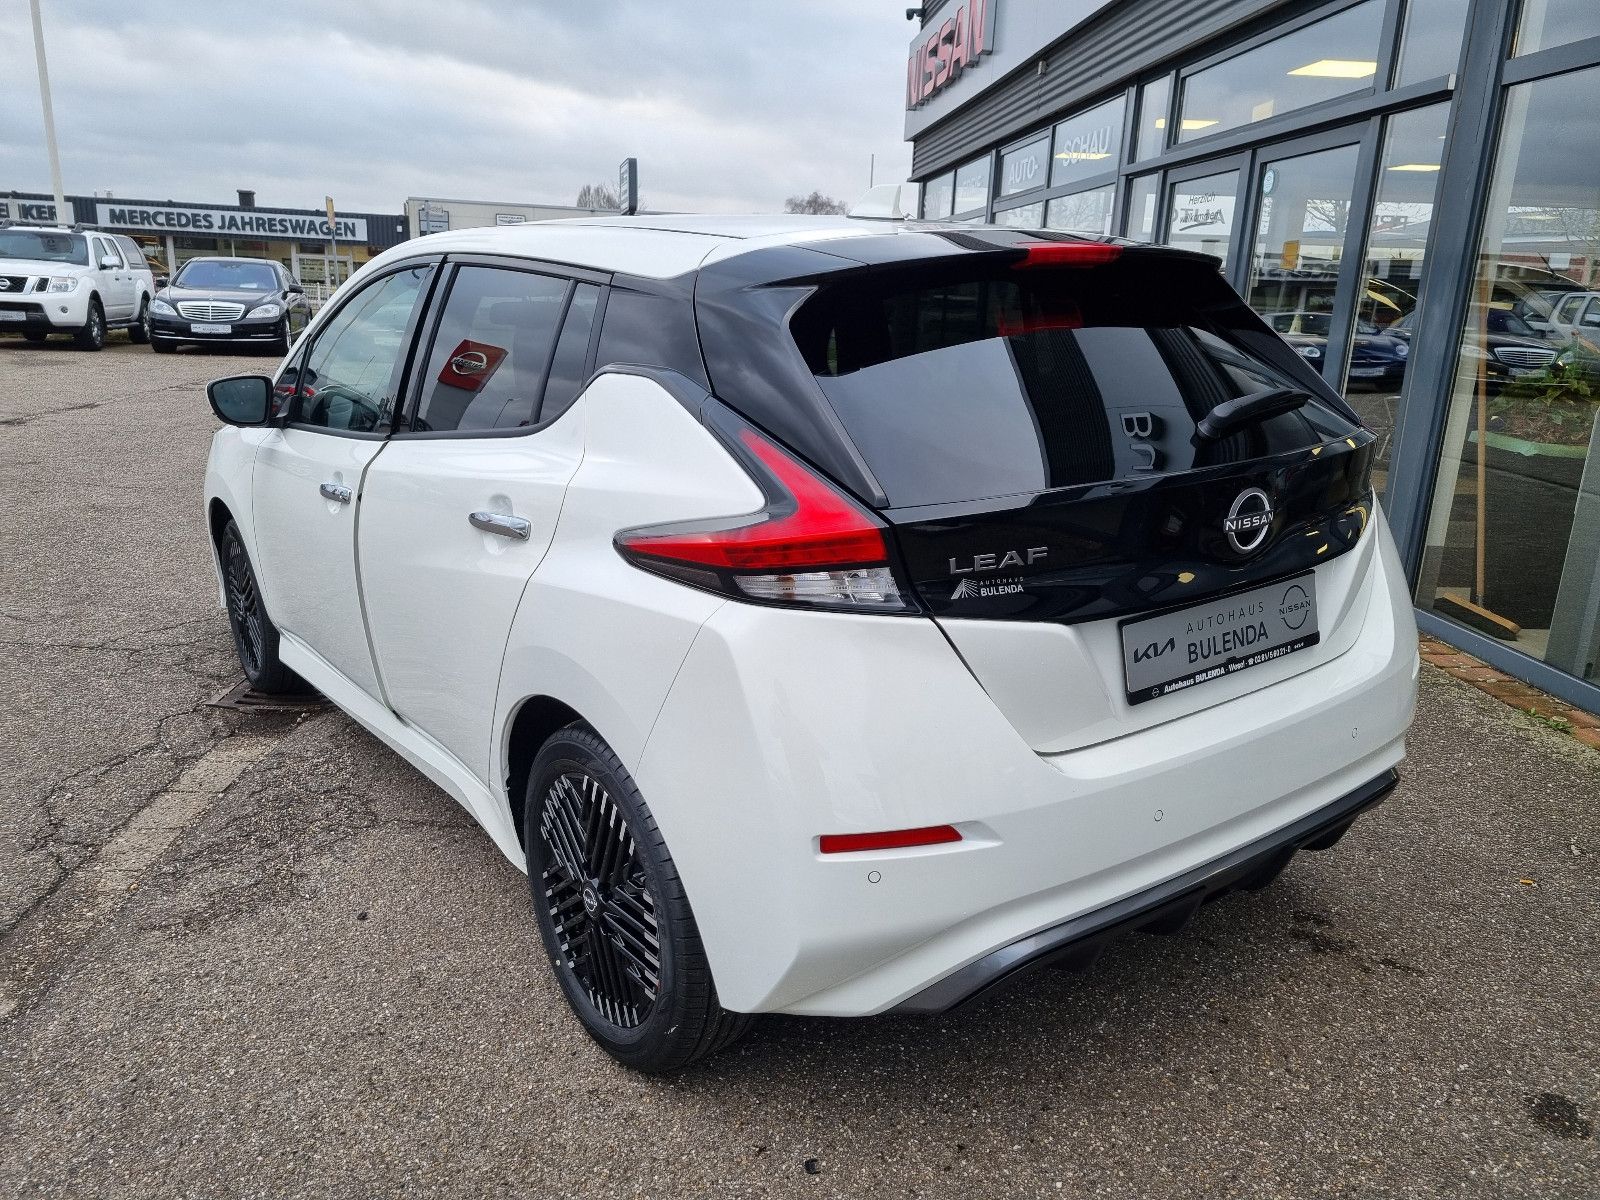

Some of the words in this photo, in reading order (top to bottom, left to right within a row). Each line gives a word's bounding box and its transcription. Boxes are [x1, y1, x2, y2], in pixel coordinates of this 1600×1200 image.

[908, 0, 986, 107] NISSAN
[1062, 125, 1111, 167] SCHAU
[109, 208, 213, 230] MERCEDES
[217, 214, 356, 238] JAHRESWAGEN
[1225, 511, 1274, 531] NISSAN
[949, 546, 1049, 575] LEAF
[980, 576, 1024, 586] AUTOHAUS
[980, 584, 1025, 597] BULENDA
[1186, 601, 1265, 635] AUTOHAUS
[1279, 599, 1311, 616] NISSAN
[1187, 621, 1269, 664] BULENDA
[1164, 678, 1194, 693] Autohaus
[1195, 667, 1225, 683] BULENDA
